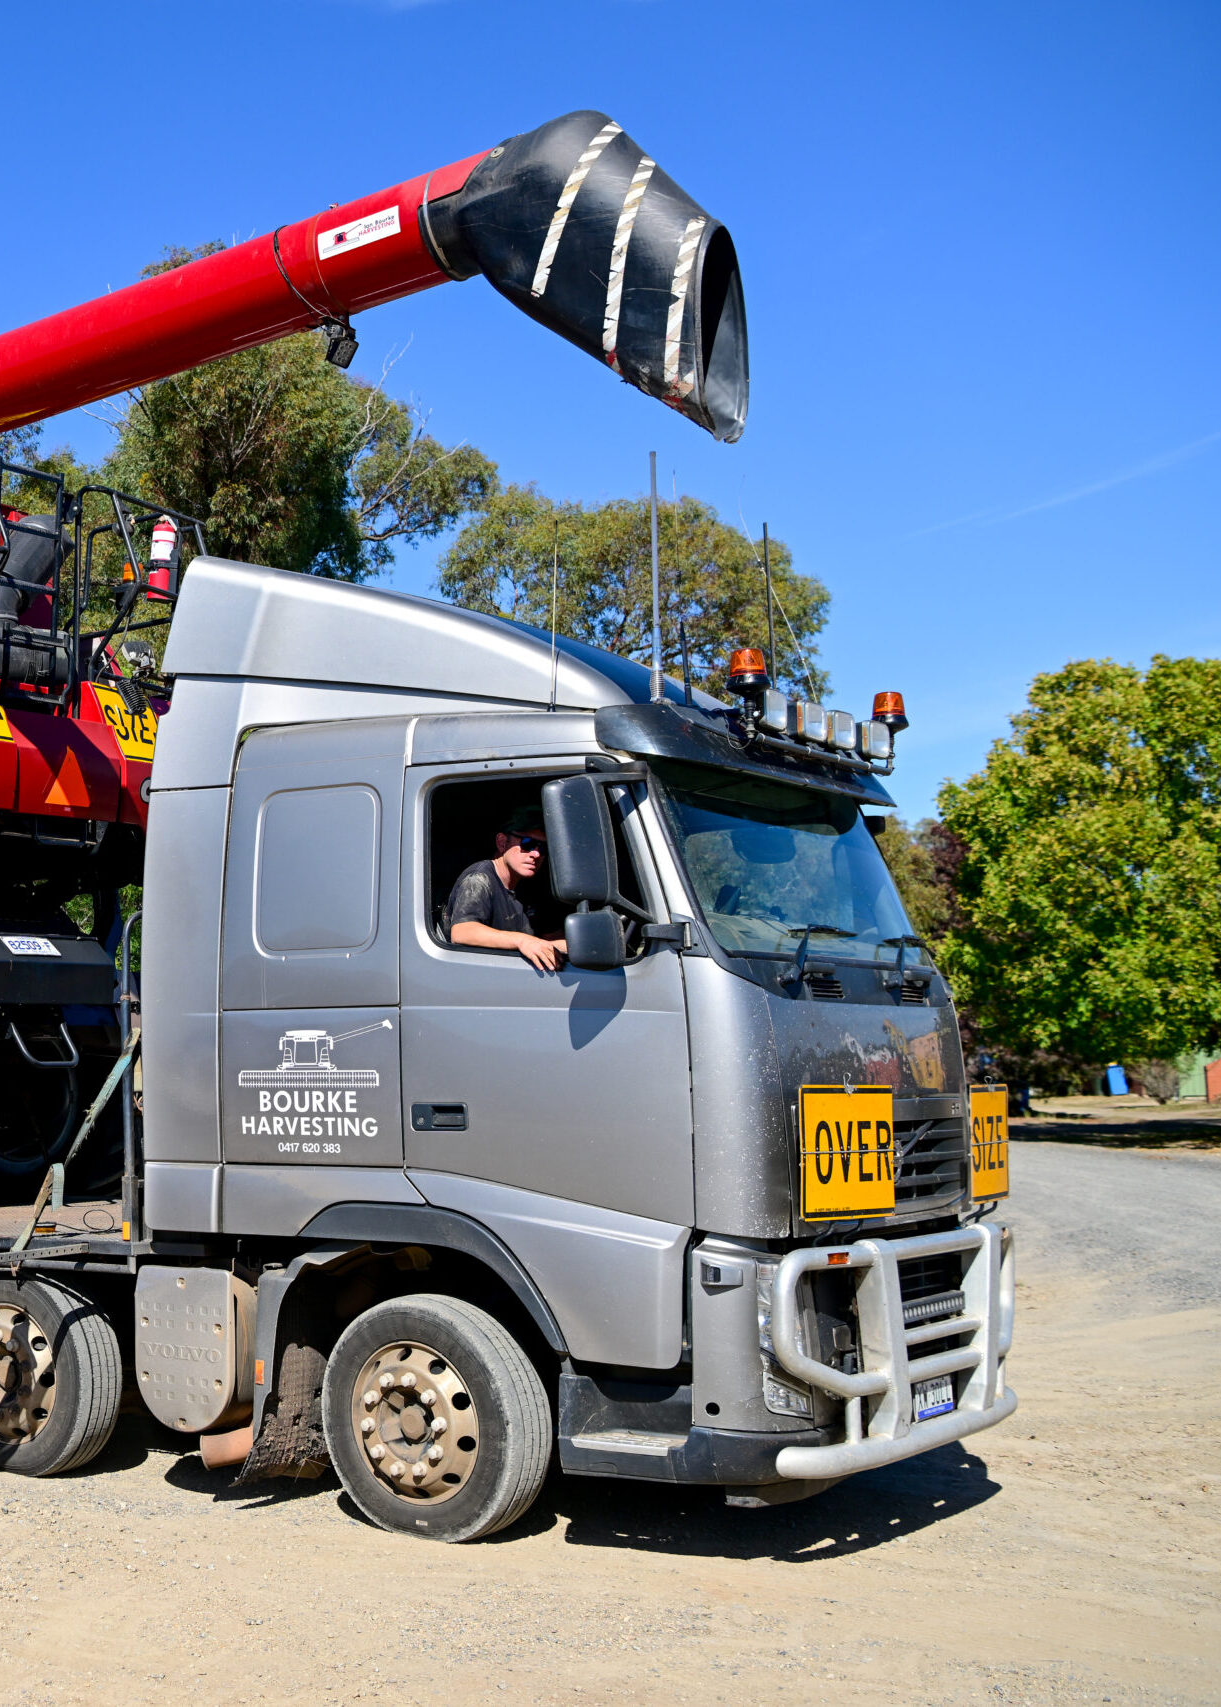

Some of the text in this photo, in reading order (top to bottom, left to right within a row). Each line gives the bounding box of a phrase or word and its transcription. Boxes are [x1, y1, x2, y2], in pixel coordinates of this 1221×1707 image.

[358, 220, 395, 236] HARVESTING
[259, 1090, 357, 1113] BOURKE
[241, 1115, 379, 1137] HARVESTING
[278, 1142, 342, 1154] 0417 620 383
[814, 1120, 893, 1185] OVER
[971, 1115, 1005, 1173] SIZE
[140, 1340, 223, 1364] VOLVO
